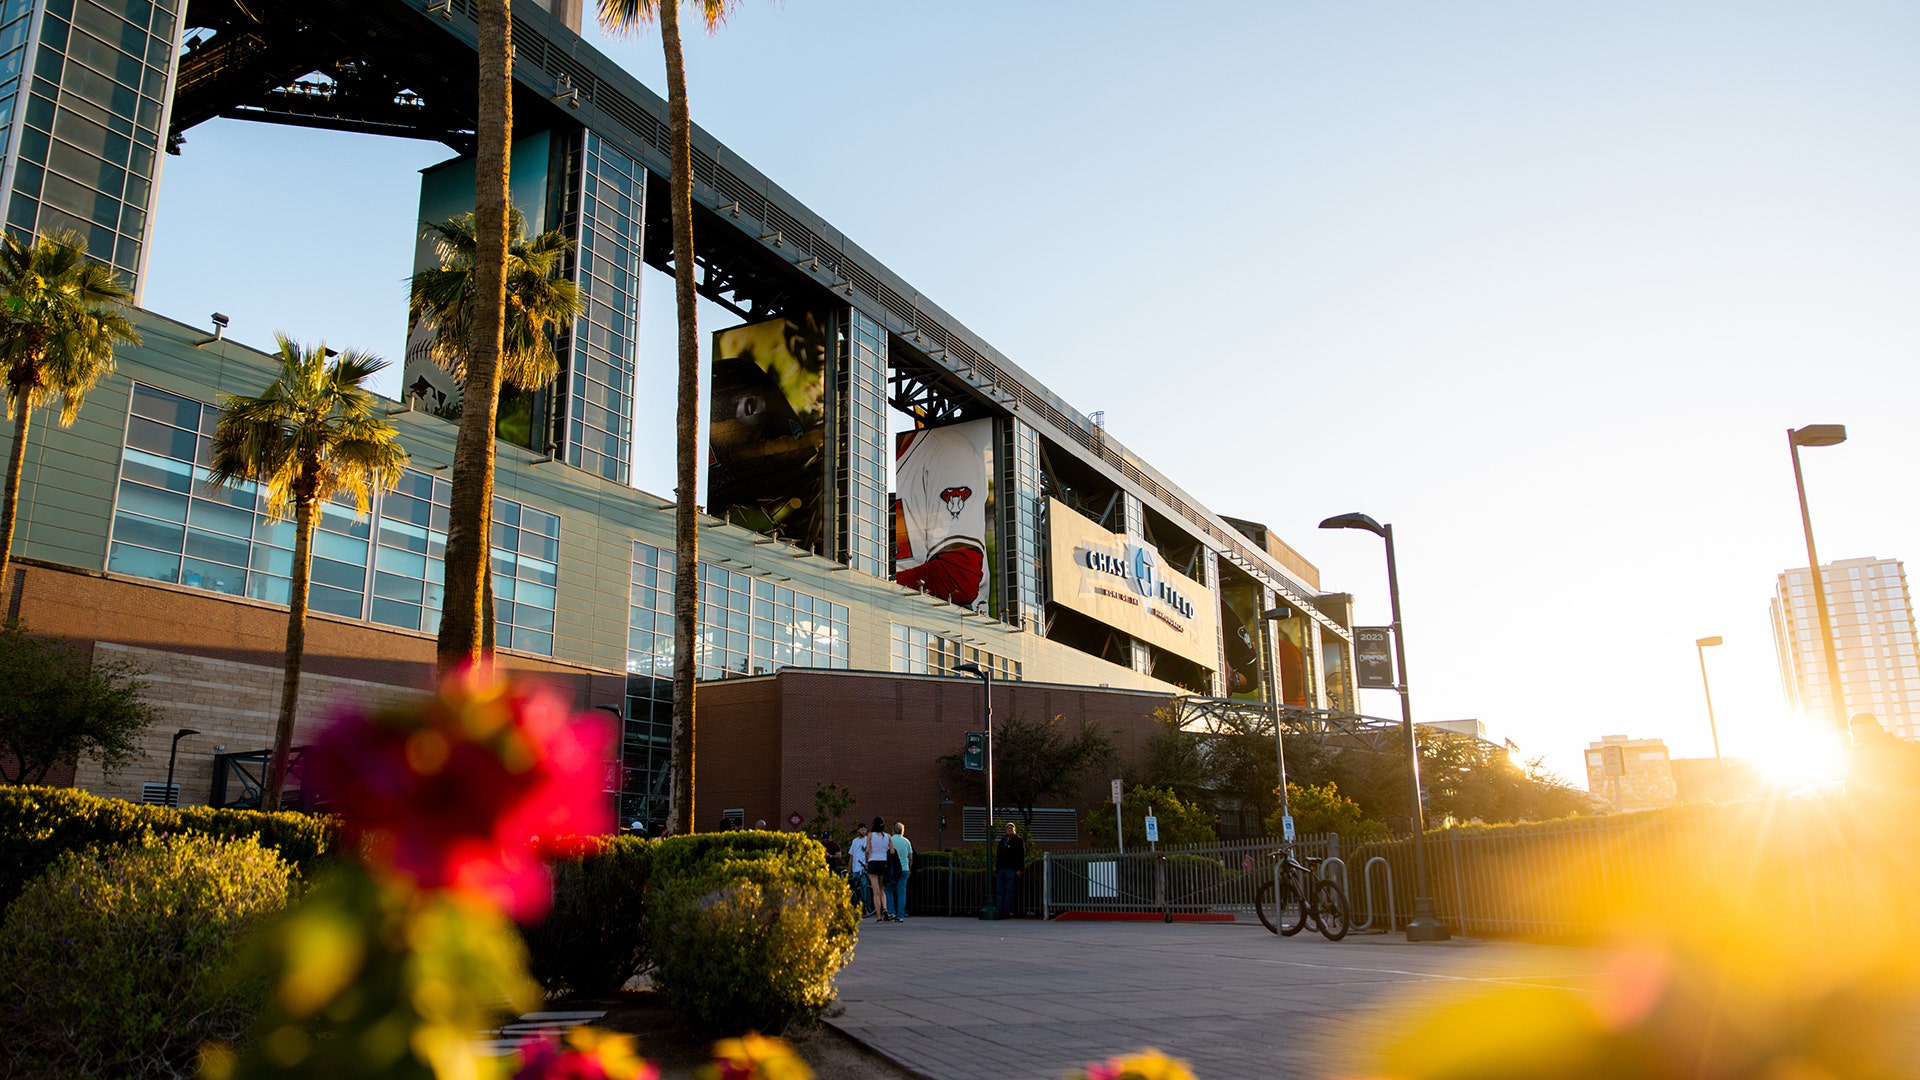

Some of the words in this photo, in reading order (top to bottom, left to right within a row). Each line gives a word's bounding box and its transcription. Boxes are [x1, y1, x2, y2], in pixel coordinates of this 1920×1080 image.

[1086, 550, 1130, 579] CHASE
[1160, 581, 1194, 619] FIELD
[1360, 633, 1384, 641] 2023
